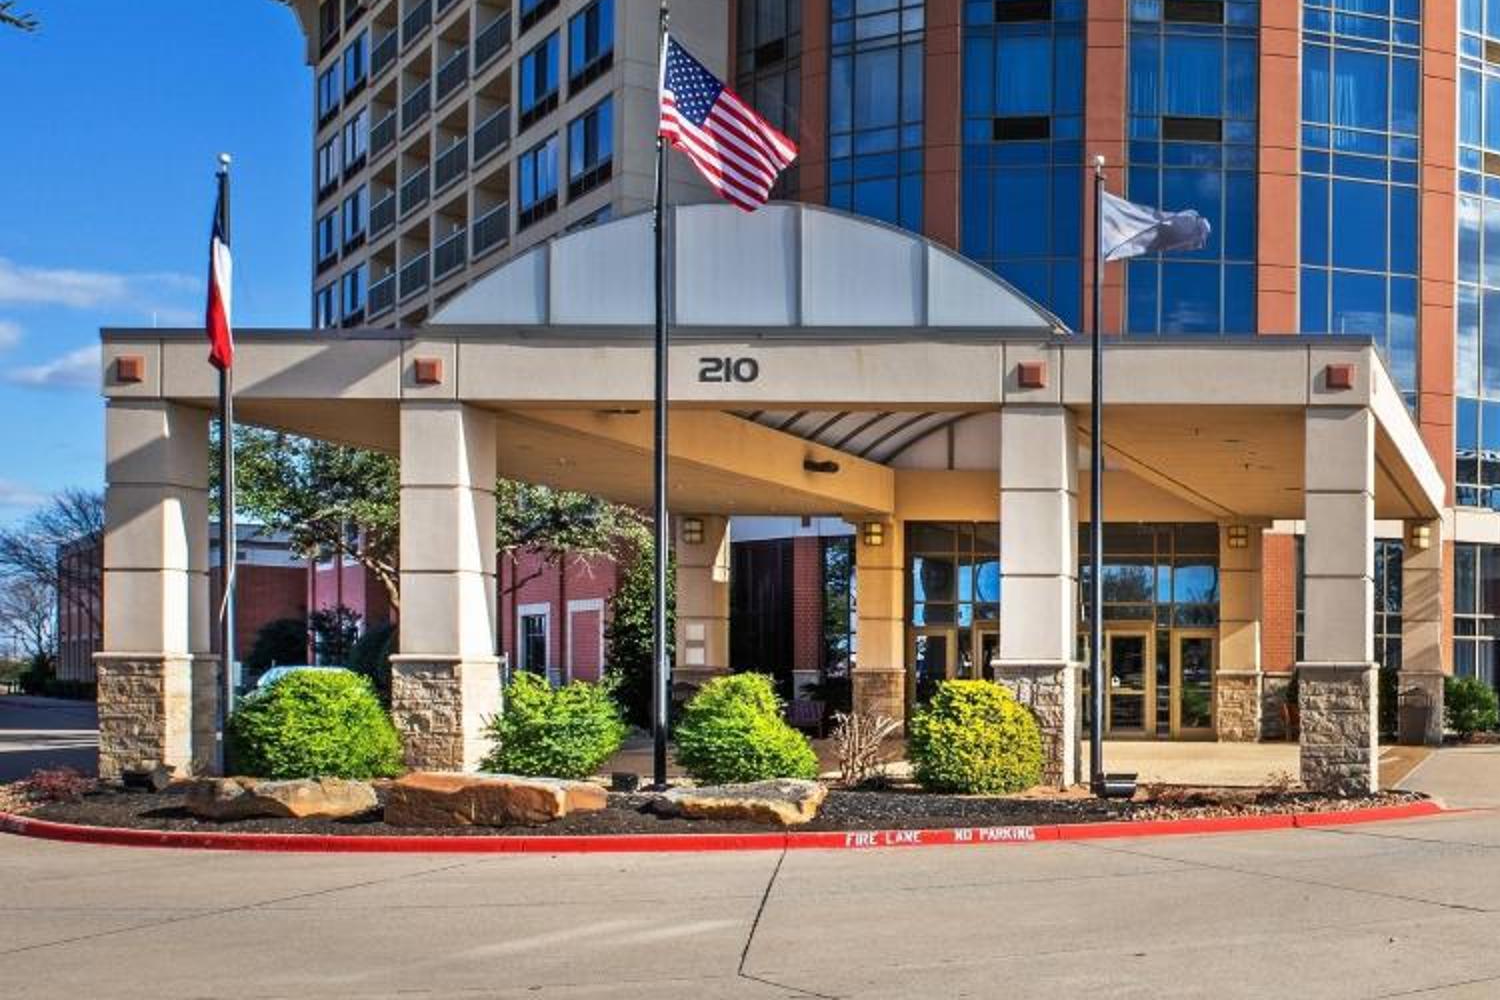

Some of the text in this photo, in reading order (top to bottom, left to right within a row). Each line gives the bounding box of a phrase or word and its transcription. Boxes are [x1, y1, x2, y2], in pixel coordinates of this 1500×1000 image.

[698, 357, 759, 382] 210
[845, 825, 1036, 846] FIRE LANE NO PARKING
